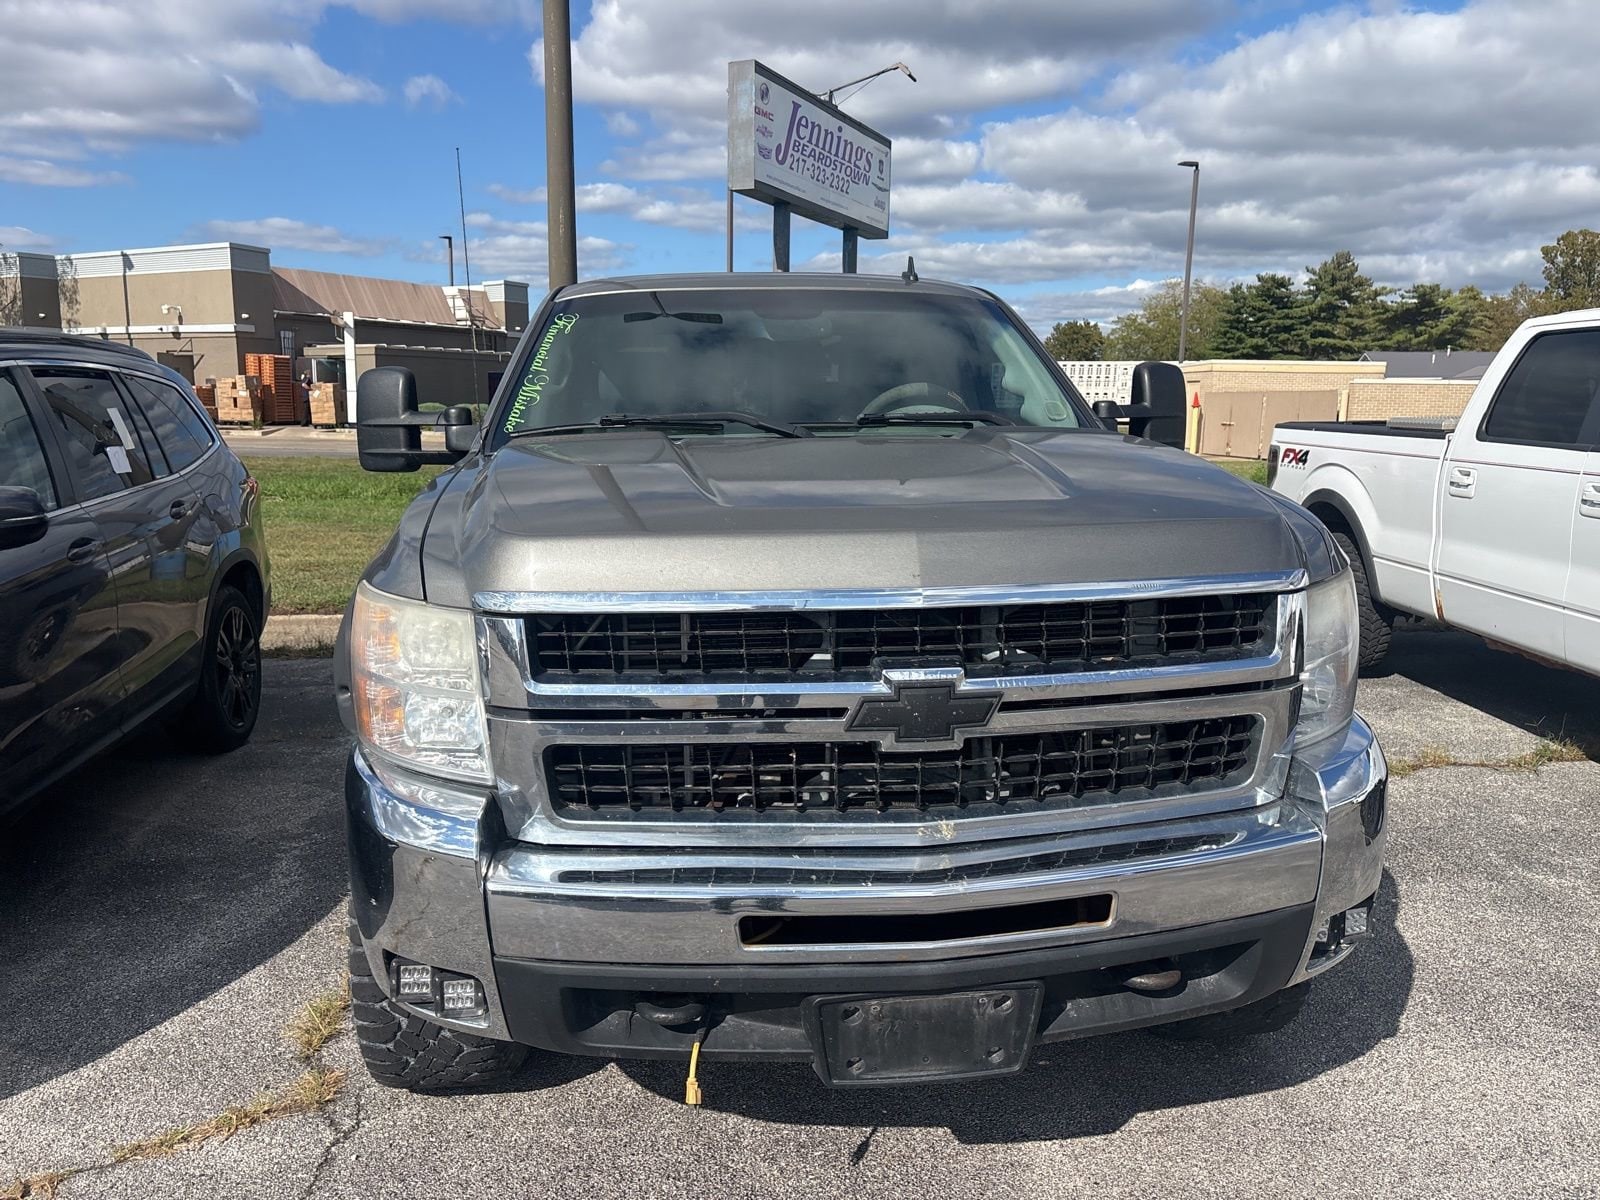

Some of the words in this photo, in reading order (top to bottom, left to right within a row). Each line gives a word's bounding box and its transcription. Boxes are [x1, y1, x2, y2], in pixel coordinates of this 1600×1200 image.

[754, 105, 774, 122] GMC
[775, 100, 874, 184] Jennings
[792, 139, 871, 186] BEARDSTOWN
[789, 153, 851, 195] 217-323-2322
[530, 313, 579, 372] Financial
[504, 374, 549, 433] Mistake
[1281, 447, 1310, 466] FX4
